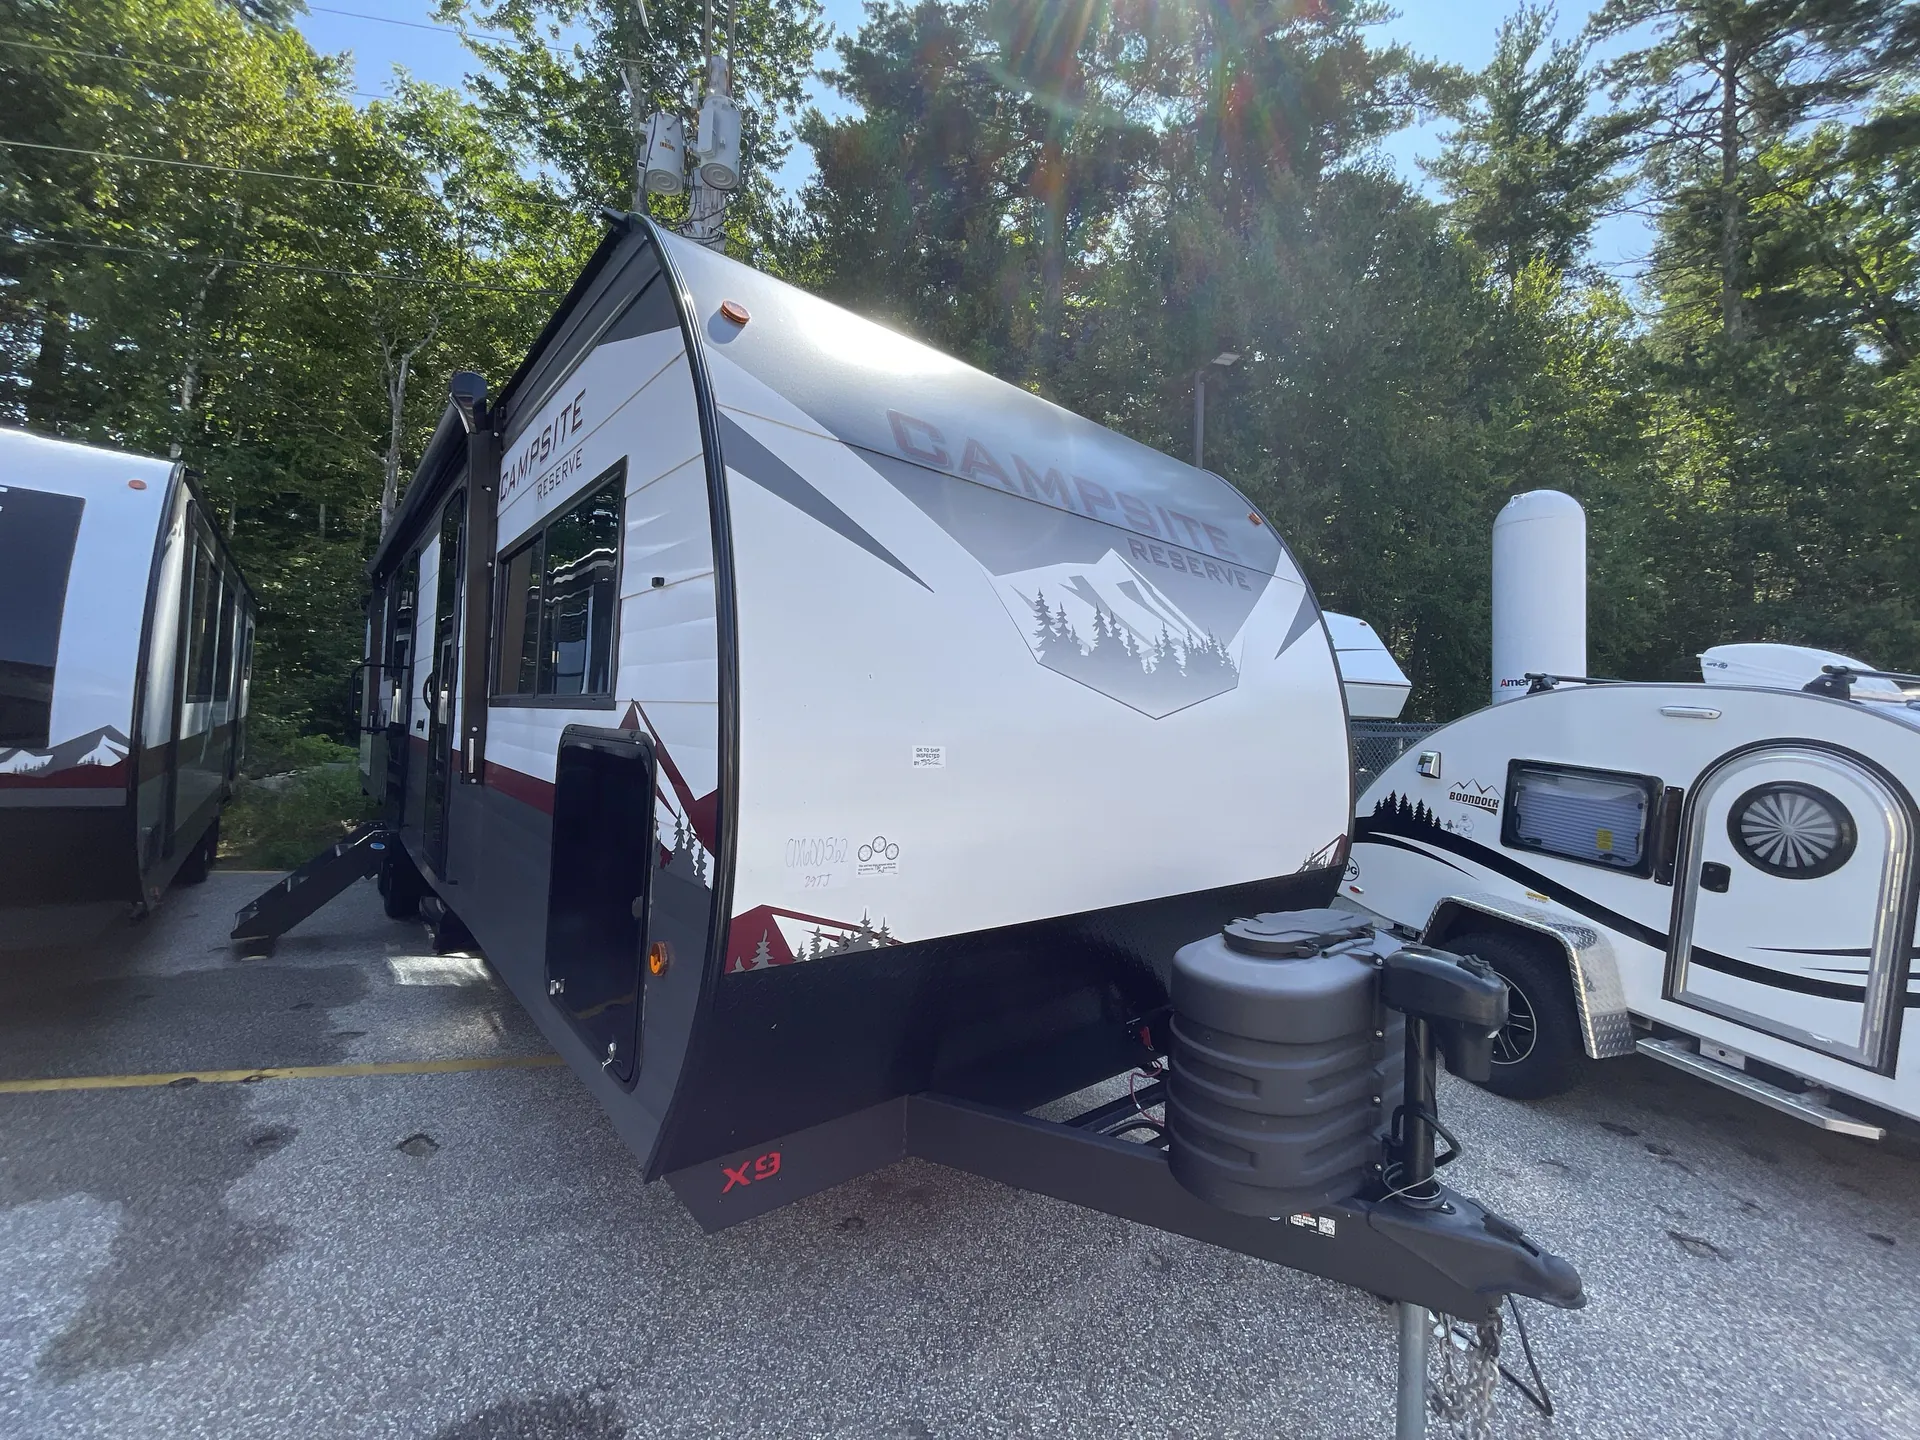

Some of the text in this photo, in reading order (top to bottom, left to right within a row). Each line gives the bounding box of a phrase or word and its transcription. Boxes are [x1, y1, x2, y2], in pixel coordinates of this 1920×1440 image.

[500, 388, 586, 501] CAMPSITE
[537, 448, 583, 500] RESERVE
[886, 408, 1240, 562] CAMPSITE
[1126, 537, 1252, 591] RESERVE
[1449, 791, 1499, 808] BOONDOCK
[720, 1151, 782, 1195] X9
